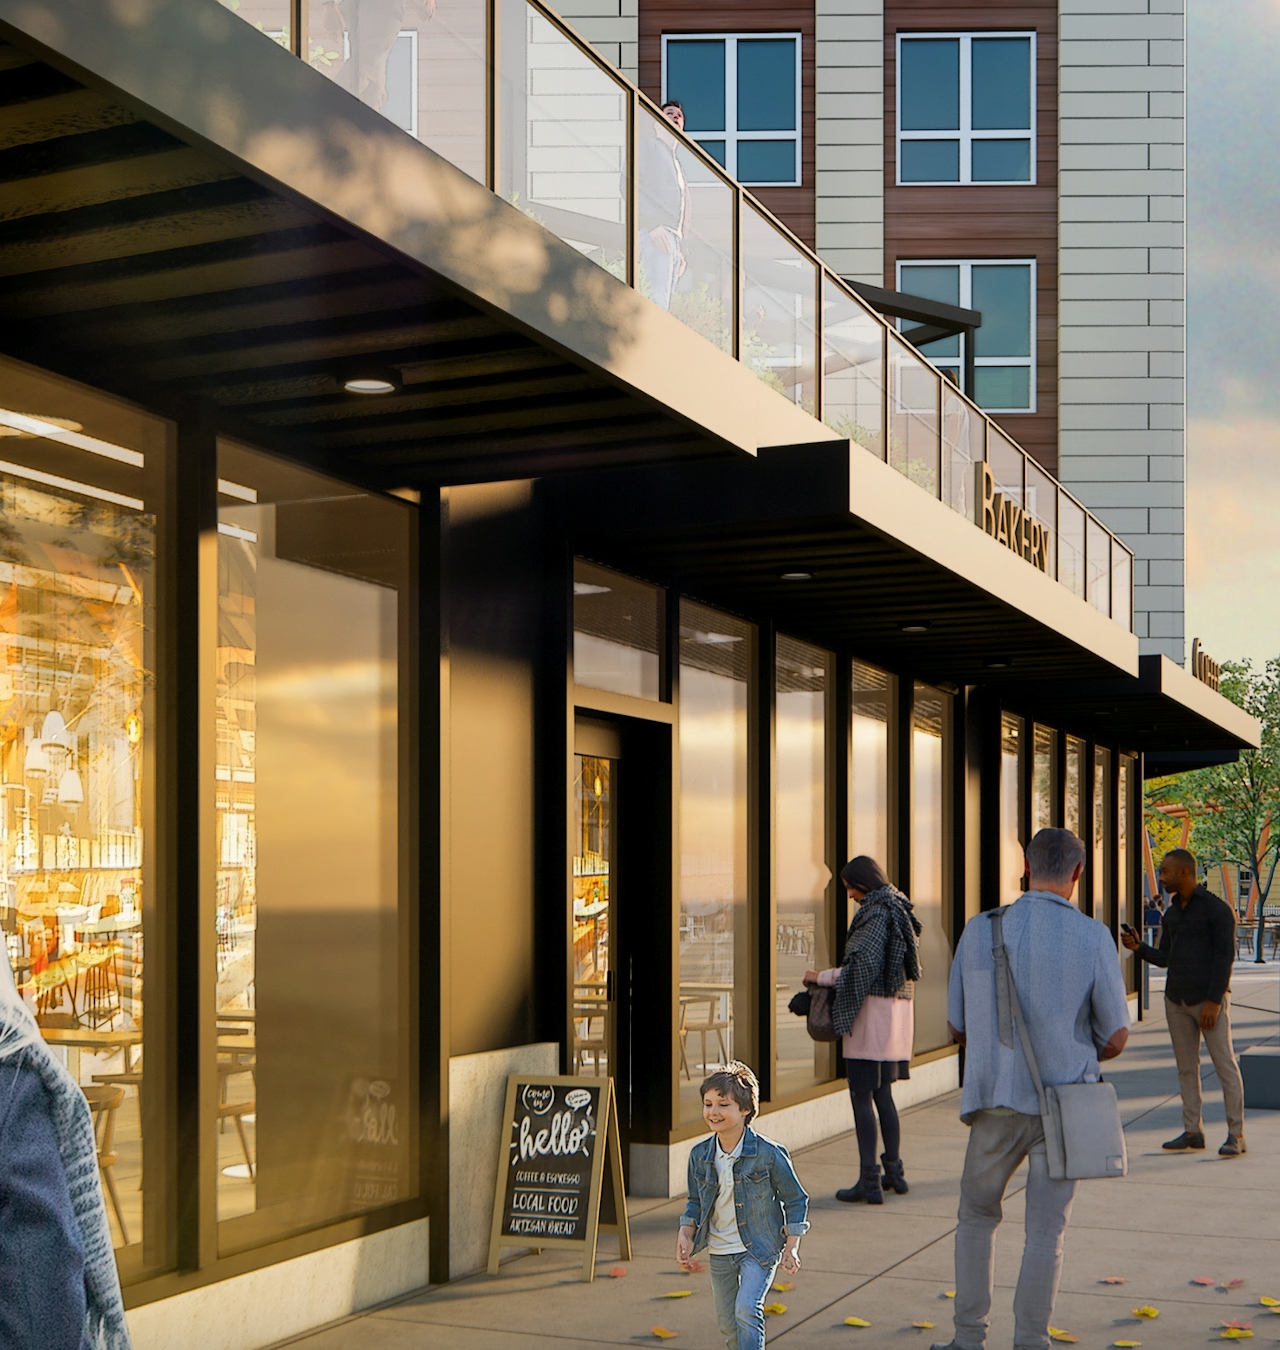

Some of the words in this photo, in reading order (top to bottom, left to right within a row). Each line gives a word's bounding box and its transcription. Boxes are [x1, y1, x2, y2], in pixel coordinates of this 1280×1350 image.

[975, 461, 1051, 573] BAKERY
[527, 1089, 551, 1099] come
[520, 1111, 589, 1162] hello
[515, 1170, 539, 1183] COFFEE
[546, 1172, 581, 1185] ESPRESSO
[512, 1192, 545, 1212] LOCAL
[547, 1195, 579, 1215] FOOD
[509, 1218, 547, 1234] ARTISAN
[547, 1221, 576, 1235] BREAD
